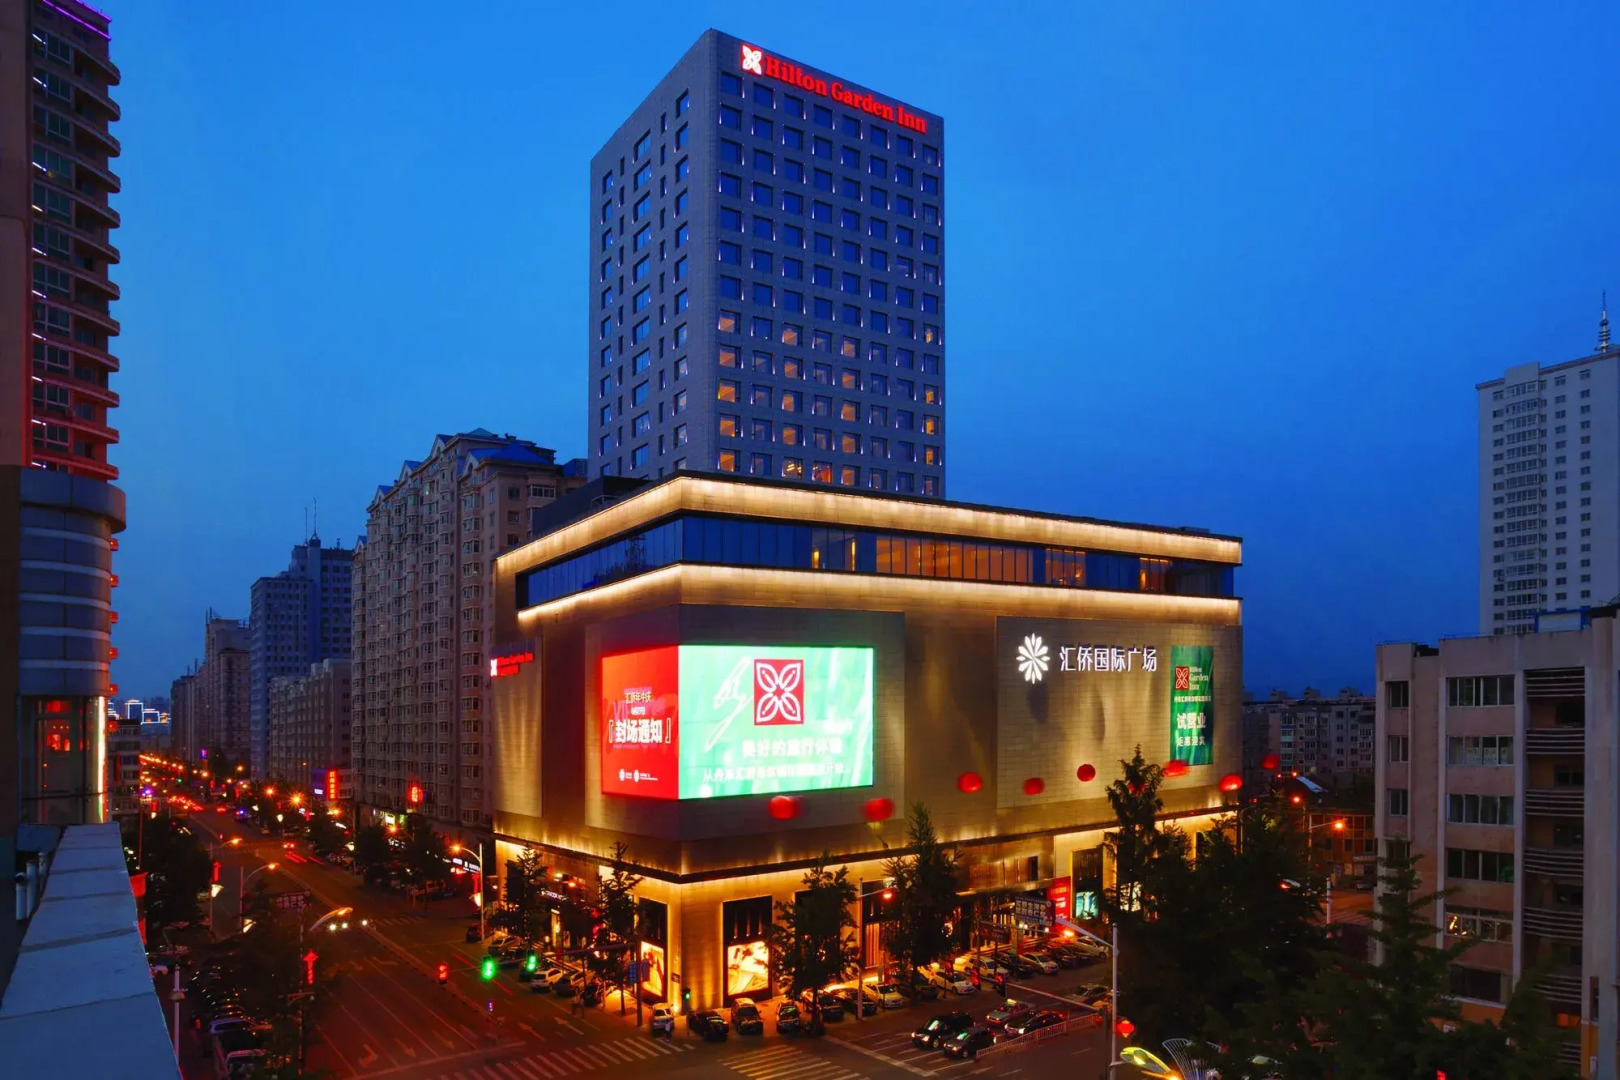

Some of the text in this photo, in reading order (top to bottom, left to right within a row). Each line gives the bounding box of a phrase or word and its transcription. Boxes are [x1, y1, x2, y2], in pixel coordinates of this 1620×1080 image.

[766, 55, 927, 134] Hilton Garden Inn
[1059, 646, 1158, 672] 汇侨国际广场
[1189, 673, 1208, 682] Garden
[1177, 712, 1206, 729] 试营业
